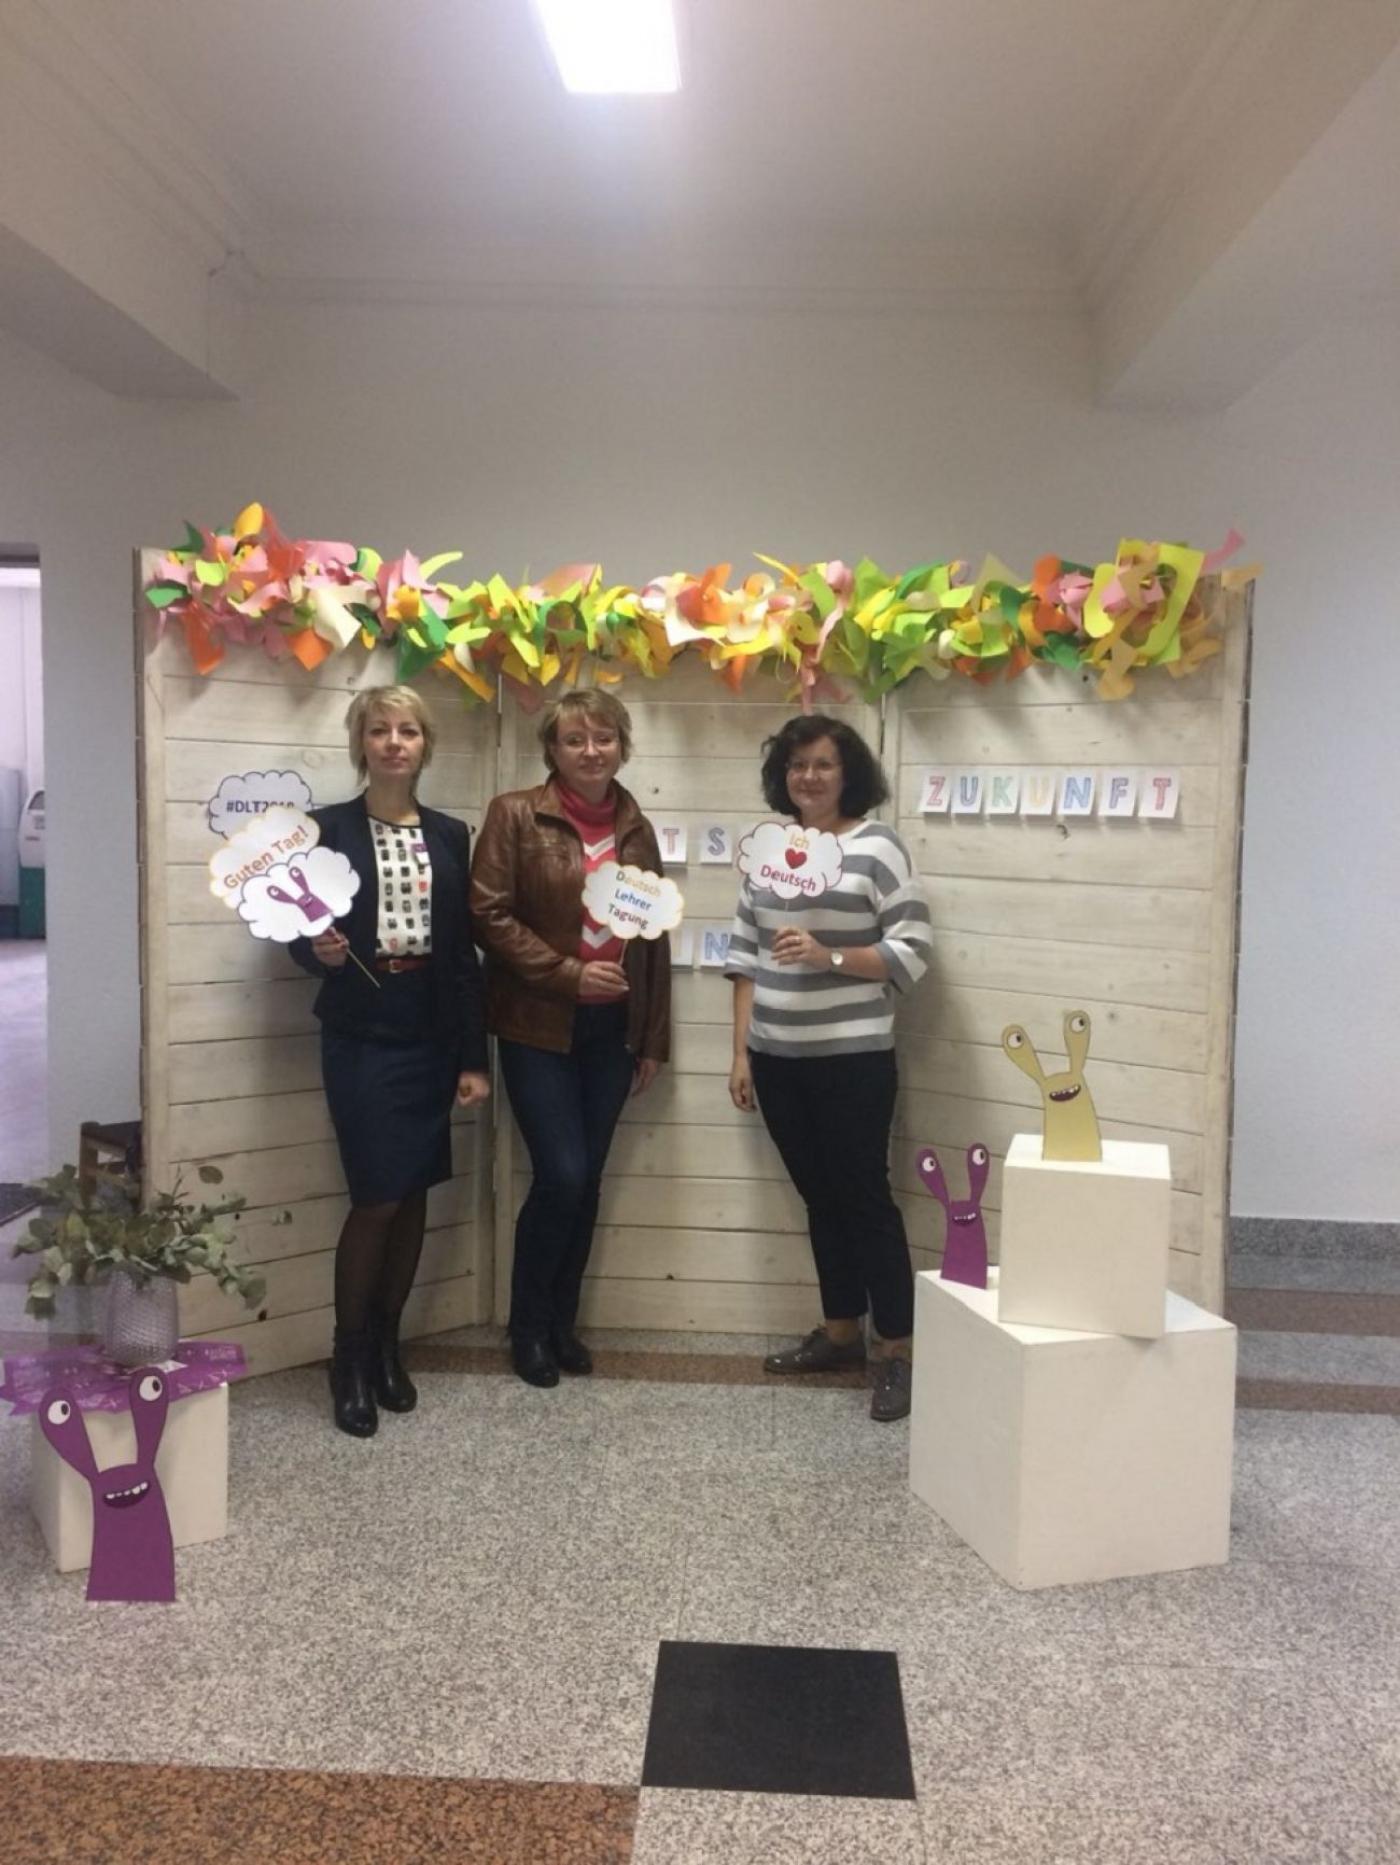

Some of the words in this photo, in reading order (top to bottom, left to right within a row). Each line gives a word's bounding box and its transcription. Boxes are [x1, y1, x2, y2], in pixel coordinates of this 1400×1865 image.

[926, 776, 1172, 811] ZUKUNFT
[789, 833, 810, 849] Ich
[223, 842, 274, 889] Guten
[272, 825, 309, 855] Tag!
[616, 870, 661, 896] Deutsch
[760, 864, 816, 892] Deutsch
[614, 889, 652, 911] Lehrer
[608, 903, 649, 930] Tagung
